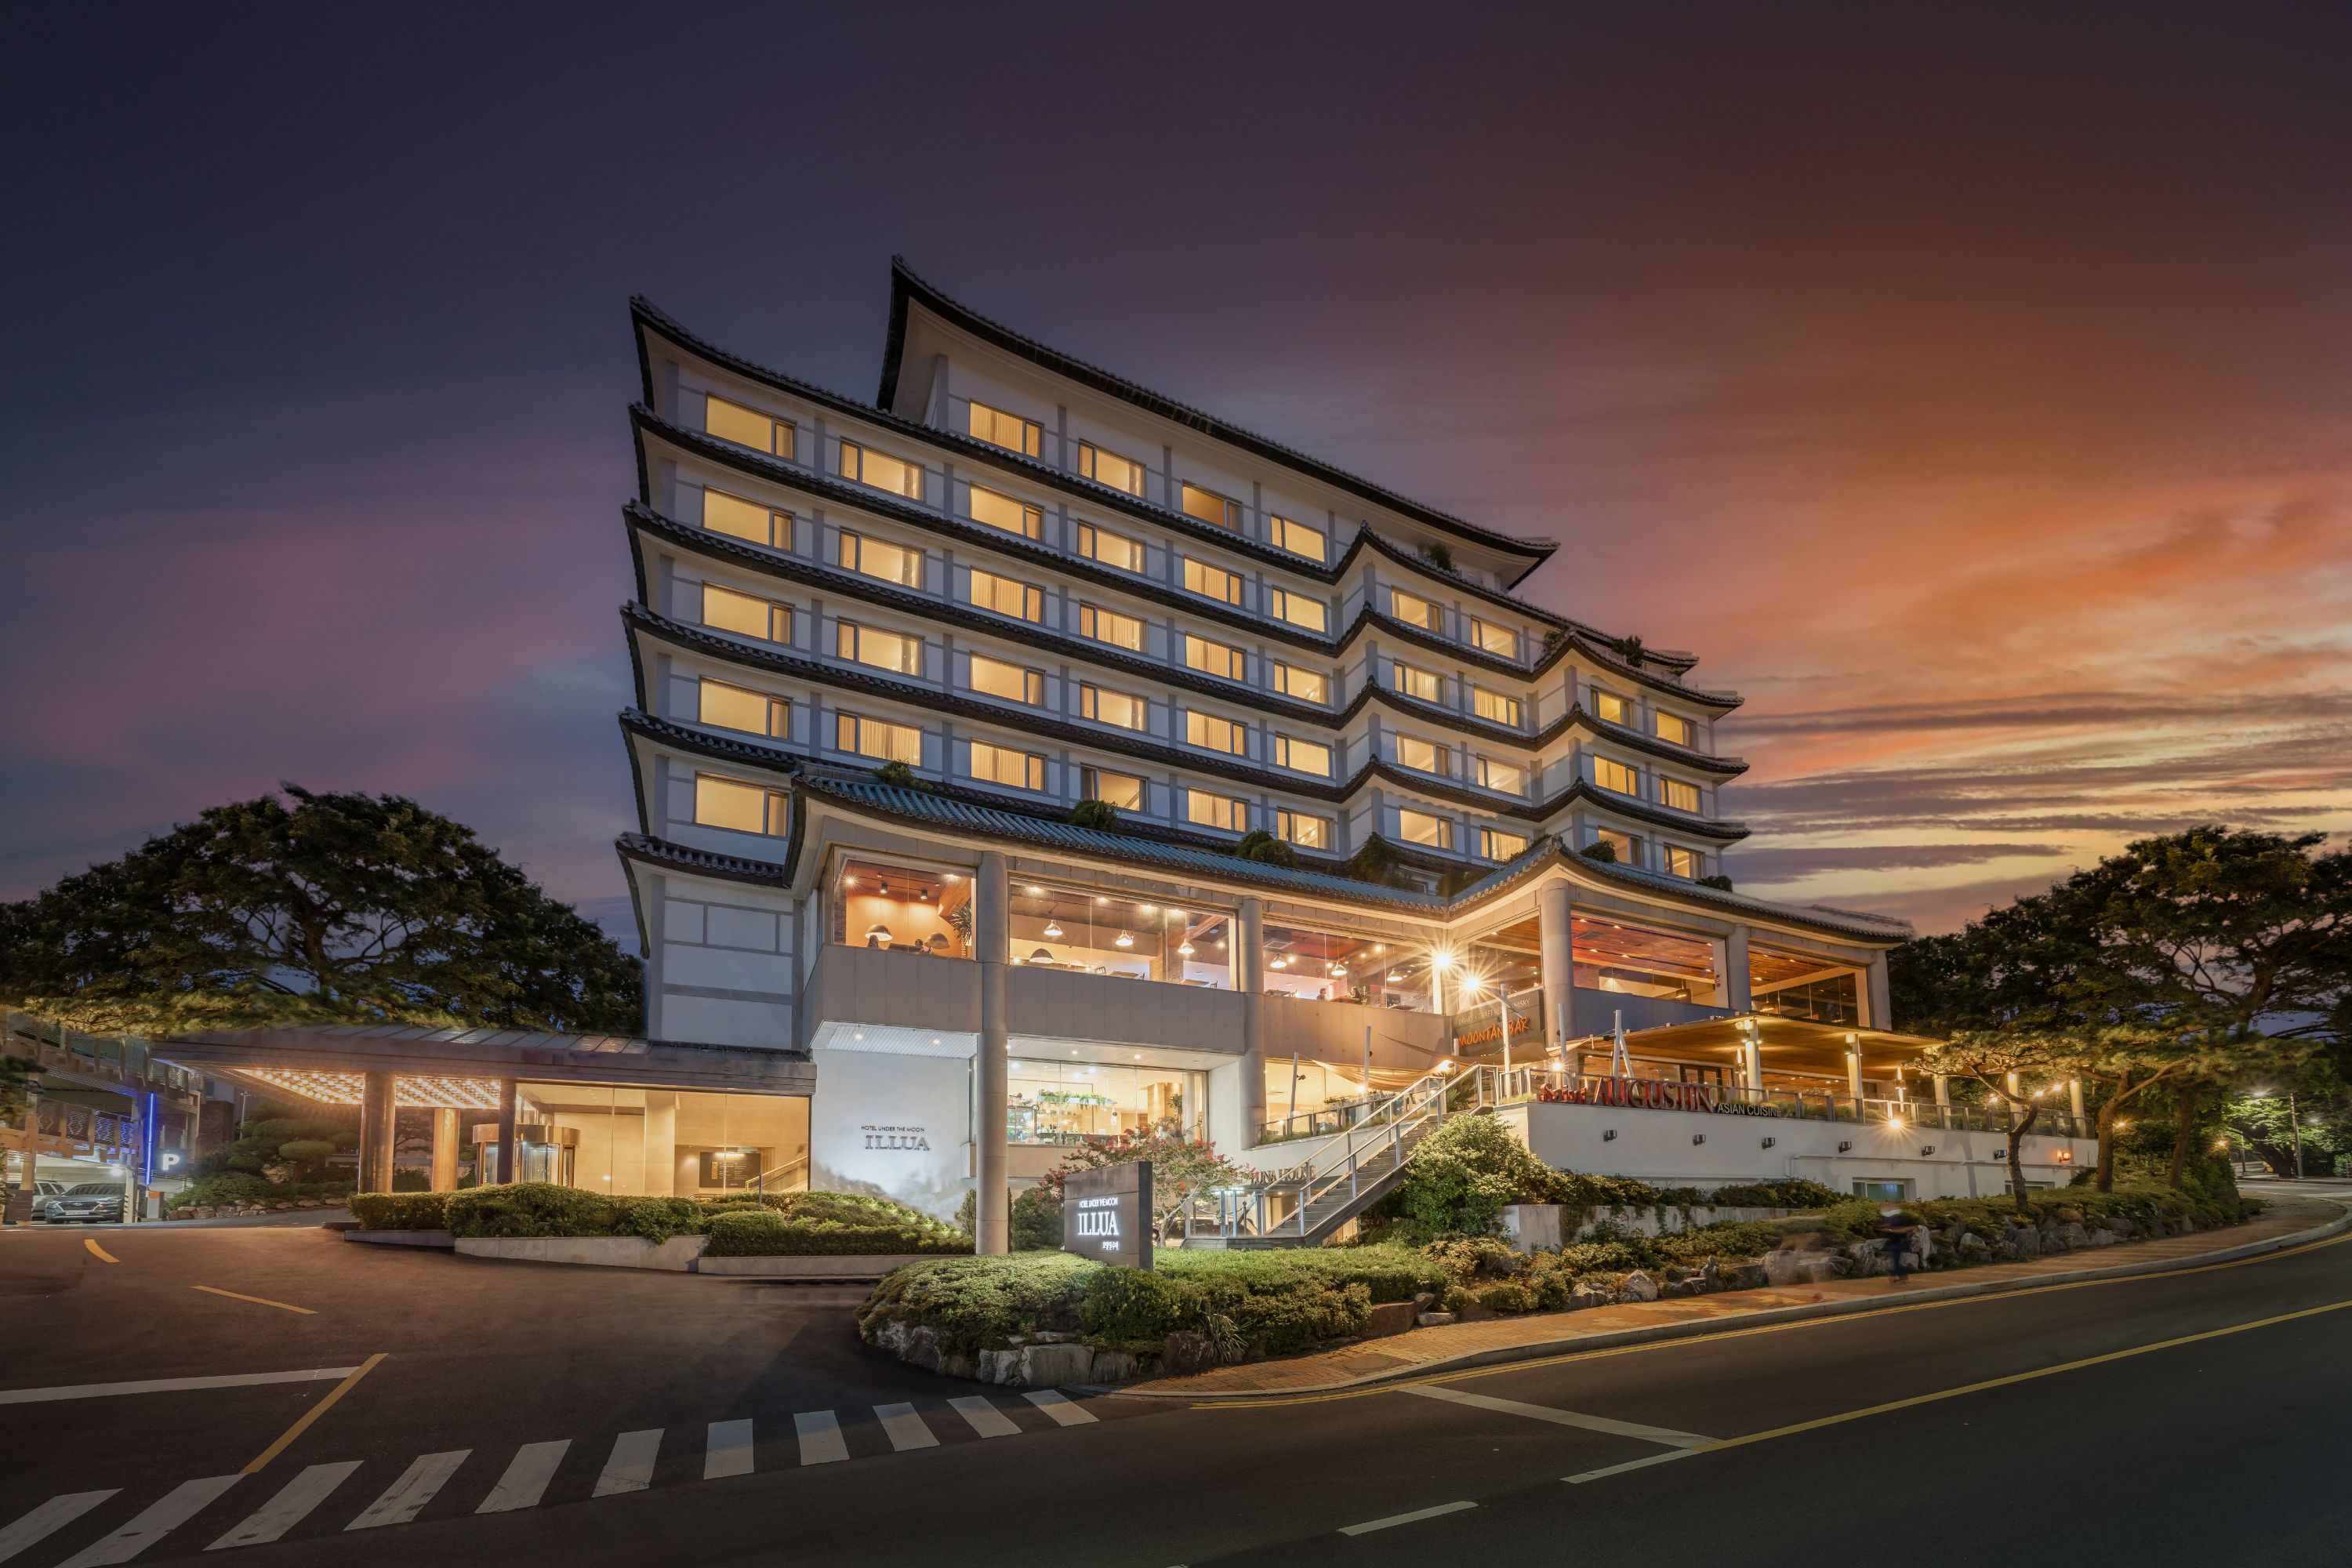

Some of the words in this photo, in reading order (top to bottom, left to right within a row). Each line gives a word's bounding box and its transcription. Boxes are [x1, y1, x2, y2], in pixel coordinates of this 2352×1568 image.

[1458, 1015, 1473, 1025] DRAFT
[1458, 1023, 1504, 1047] MOONTAN
[1508, 1017, 1530, 1036] BAR
[1592, 1076, 1713, 1113] AUGUSTIN
[1717, 1102, 1745, 1115] ASIAN
[1747, 1105, 1782, 1117] CUISINE
[865, 1134, 931, 1151] ILLUA
[162, 1153, 180, 1171] P
[1079, 1200, 1088, 1208] HOTEL
[1105, 1197, 1118, 1206] MOON
[1078, 1210, 1120, 1236] ILLUA
